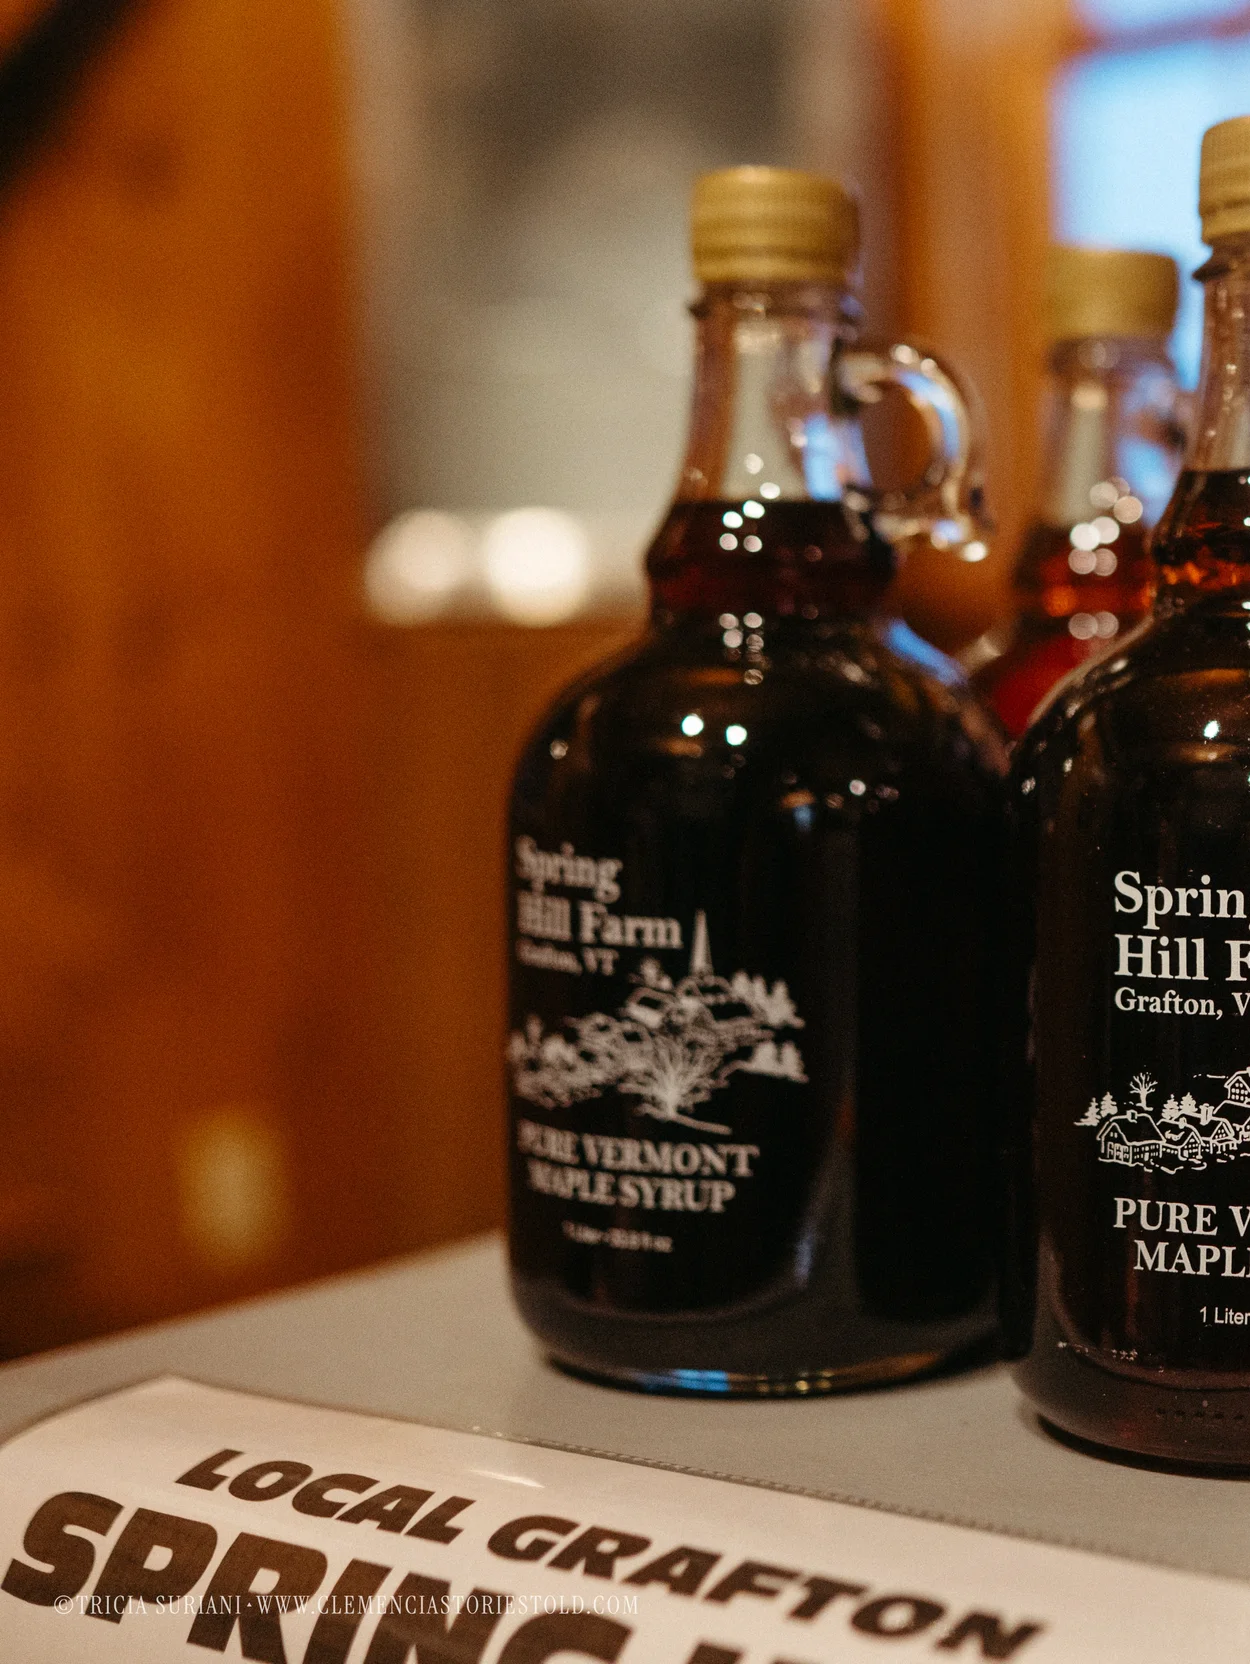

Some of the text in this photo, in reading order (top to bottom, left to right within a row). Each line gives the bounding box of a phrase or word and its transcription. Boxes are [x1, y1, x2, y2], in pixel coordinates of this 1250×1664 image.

[578, 901, 683, 949] Farm
[1113, 933, 1209, 981] Hill
[1113, 986, 1223, 1020] Grafton,
[582, 1133, 760, 1177] VERMONT
[528, 1158, 736, 1213] MAPLE SYRUP
[1112, 1196, 1218, 1236] PURE
[1199, 1306, 1208, 1324] 1
[174, 1448, 1044, 1662] LOCAL GRAFTON
